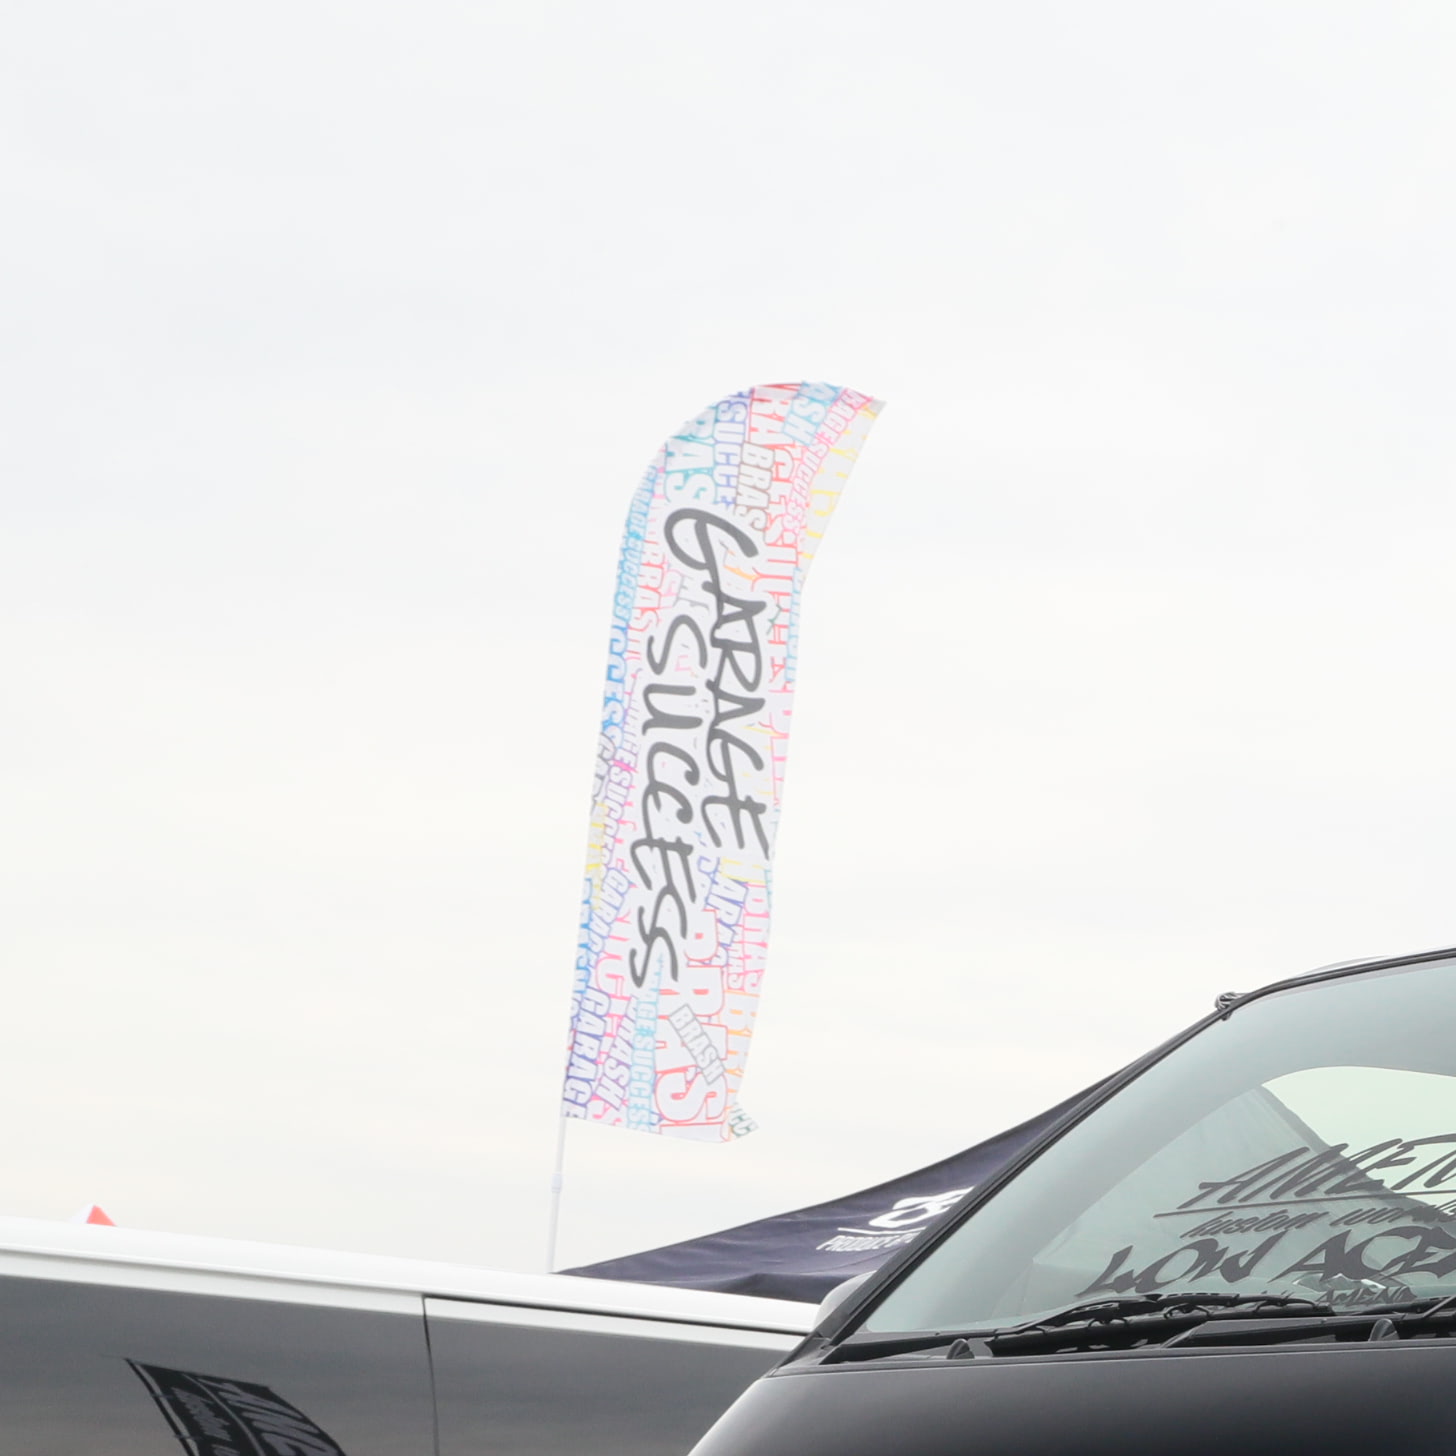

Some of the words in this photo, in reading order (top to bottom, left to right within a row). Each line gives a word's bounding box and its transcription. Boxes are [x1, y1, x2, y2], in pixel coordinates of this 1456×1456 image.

[664, 508, 770, 860] GARAGE
[629, 614, 708, 989] SUCCESS
[674, 1007, 725, 1082] BRASH
[1180, 1207, 1328, 1240] kustom
[1075, 1230, 1287, 1298] LOW
